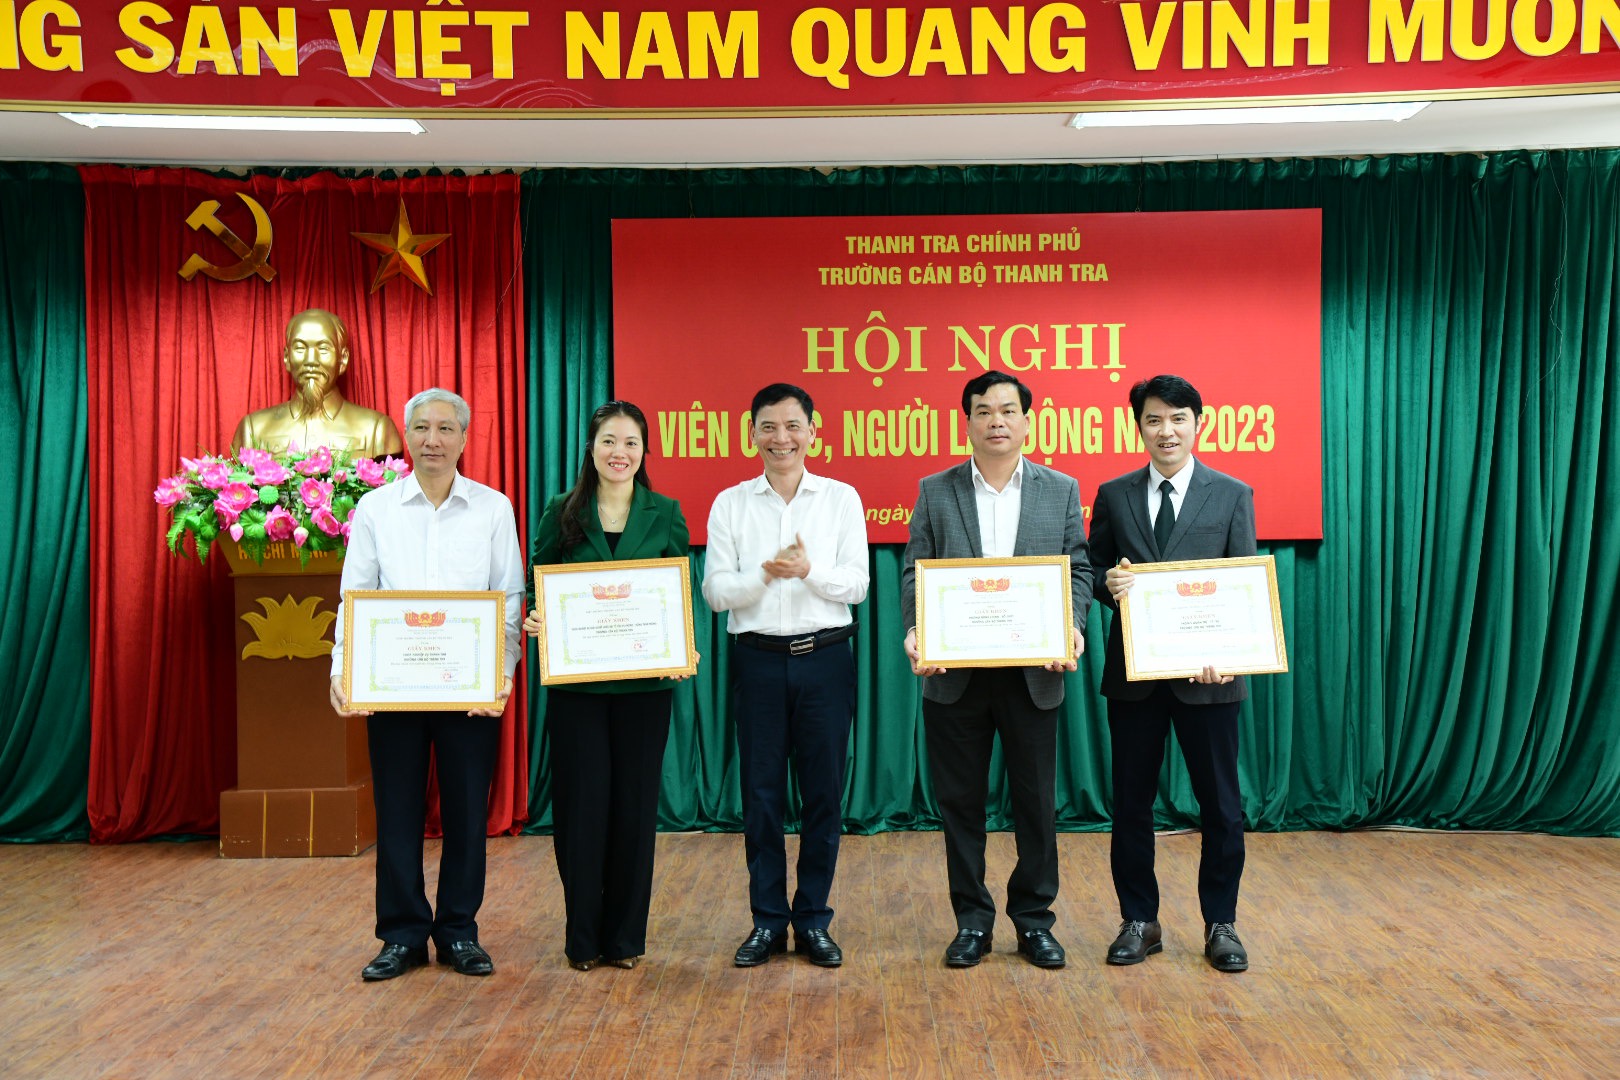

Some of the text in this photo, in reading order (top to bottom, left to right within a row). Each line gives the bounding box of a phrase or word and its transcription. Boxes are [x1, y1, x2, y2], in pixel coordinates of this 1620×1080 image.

[328, 0, 529, 96] VIỆT
[565, 10, 759, 80] NAM
[791, 2, 1086, 89] QUANG
[1120, 0, 1330, 71] VINH
[846, 226, 1081, 254] THANH TRA CHÍNH PHỦ
[818, 261, 1109, 287] TRƯỜNG CÁN BỘ THANH TRA
[801, 310, 1127, 387] HỘI NGHỊ
[658, 401, 730, 458] VIÊN
[843, 397, 939, 457] NGƯỜI
[1198, 404, 1275, 453] 2023
[866, 503, 914, 526] ngày
